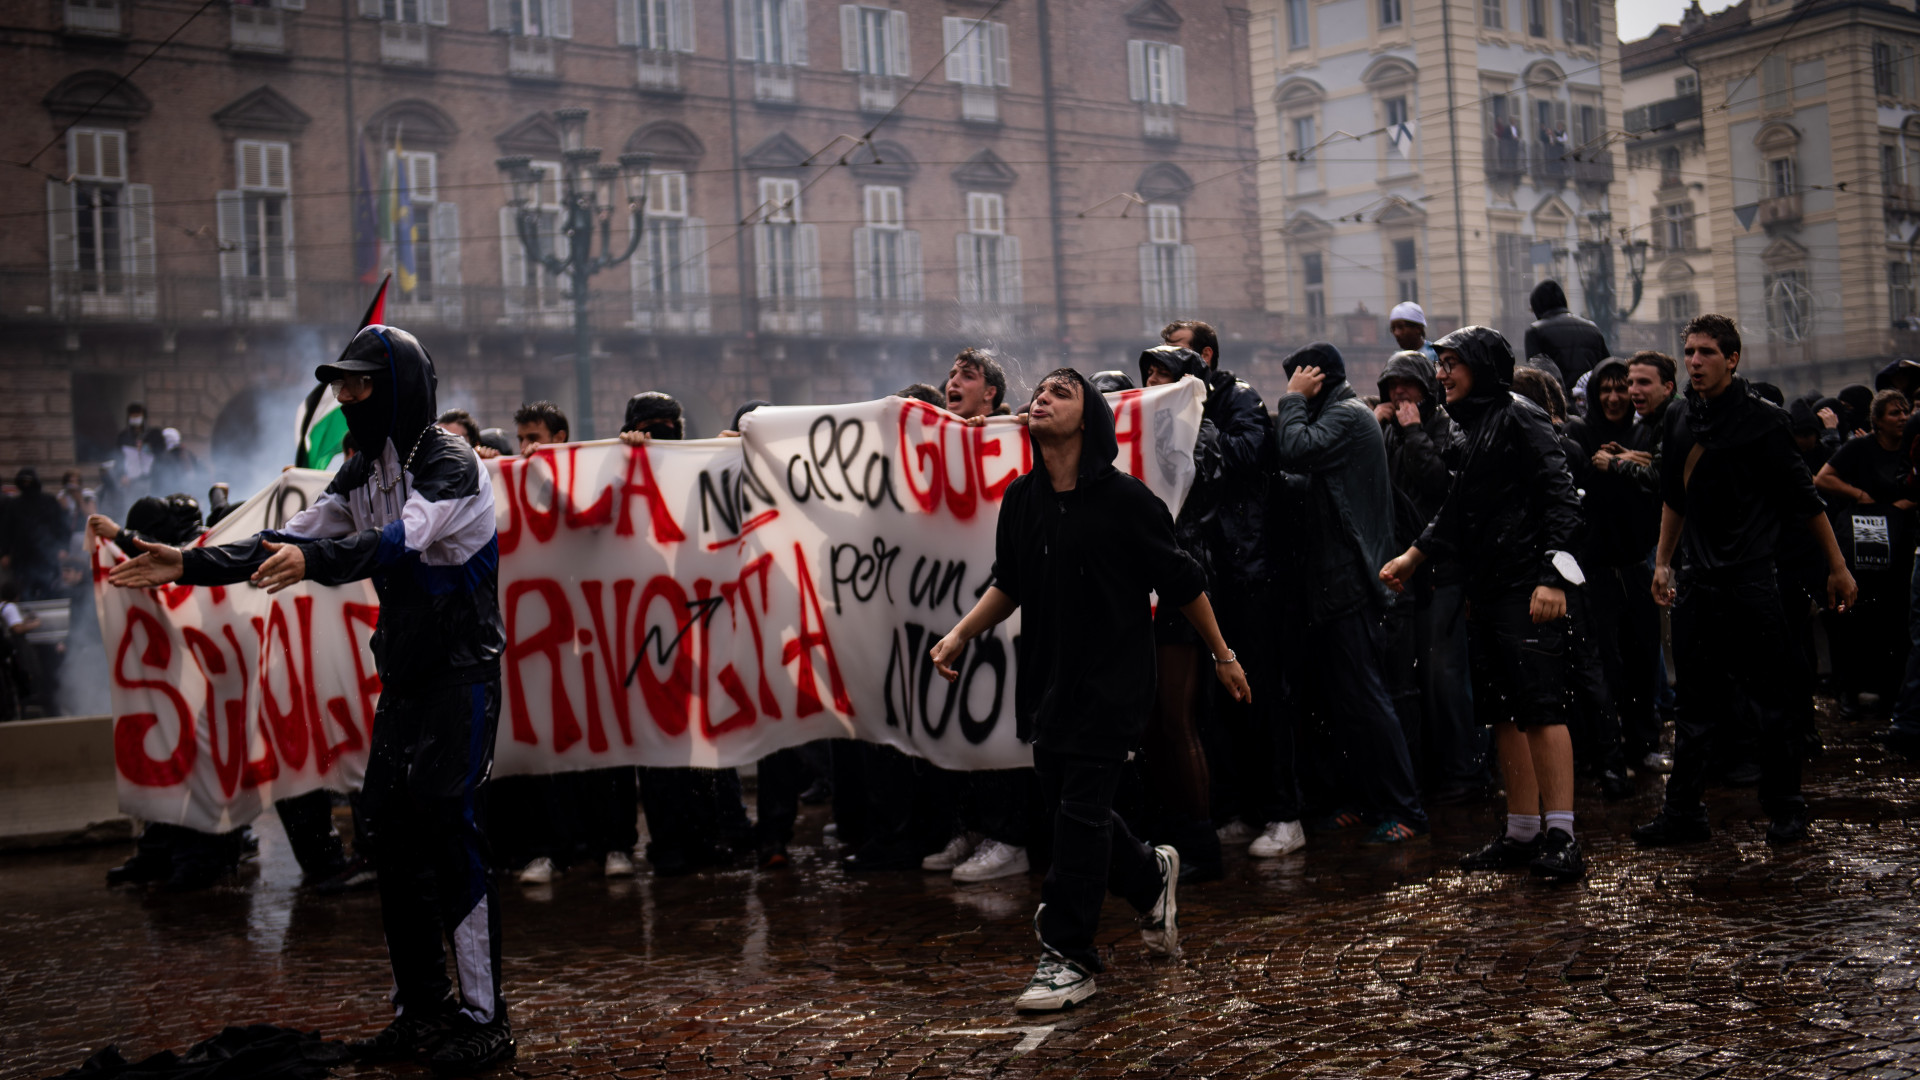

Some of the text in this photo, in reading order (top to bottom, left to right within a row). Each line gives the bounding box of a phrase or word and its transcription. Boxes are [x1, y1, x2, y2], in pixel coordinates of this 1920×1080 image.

[788, 414, 904, 514] alla
[900, 388, 1144, 520] GUEA
[831, 537, 901, 615] per
